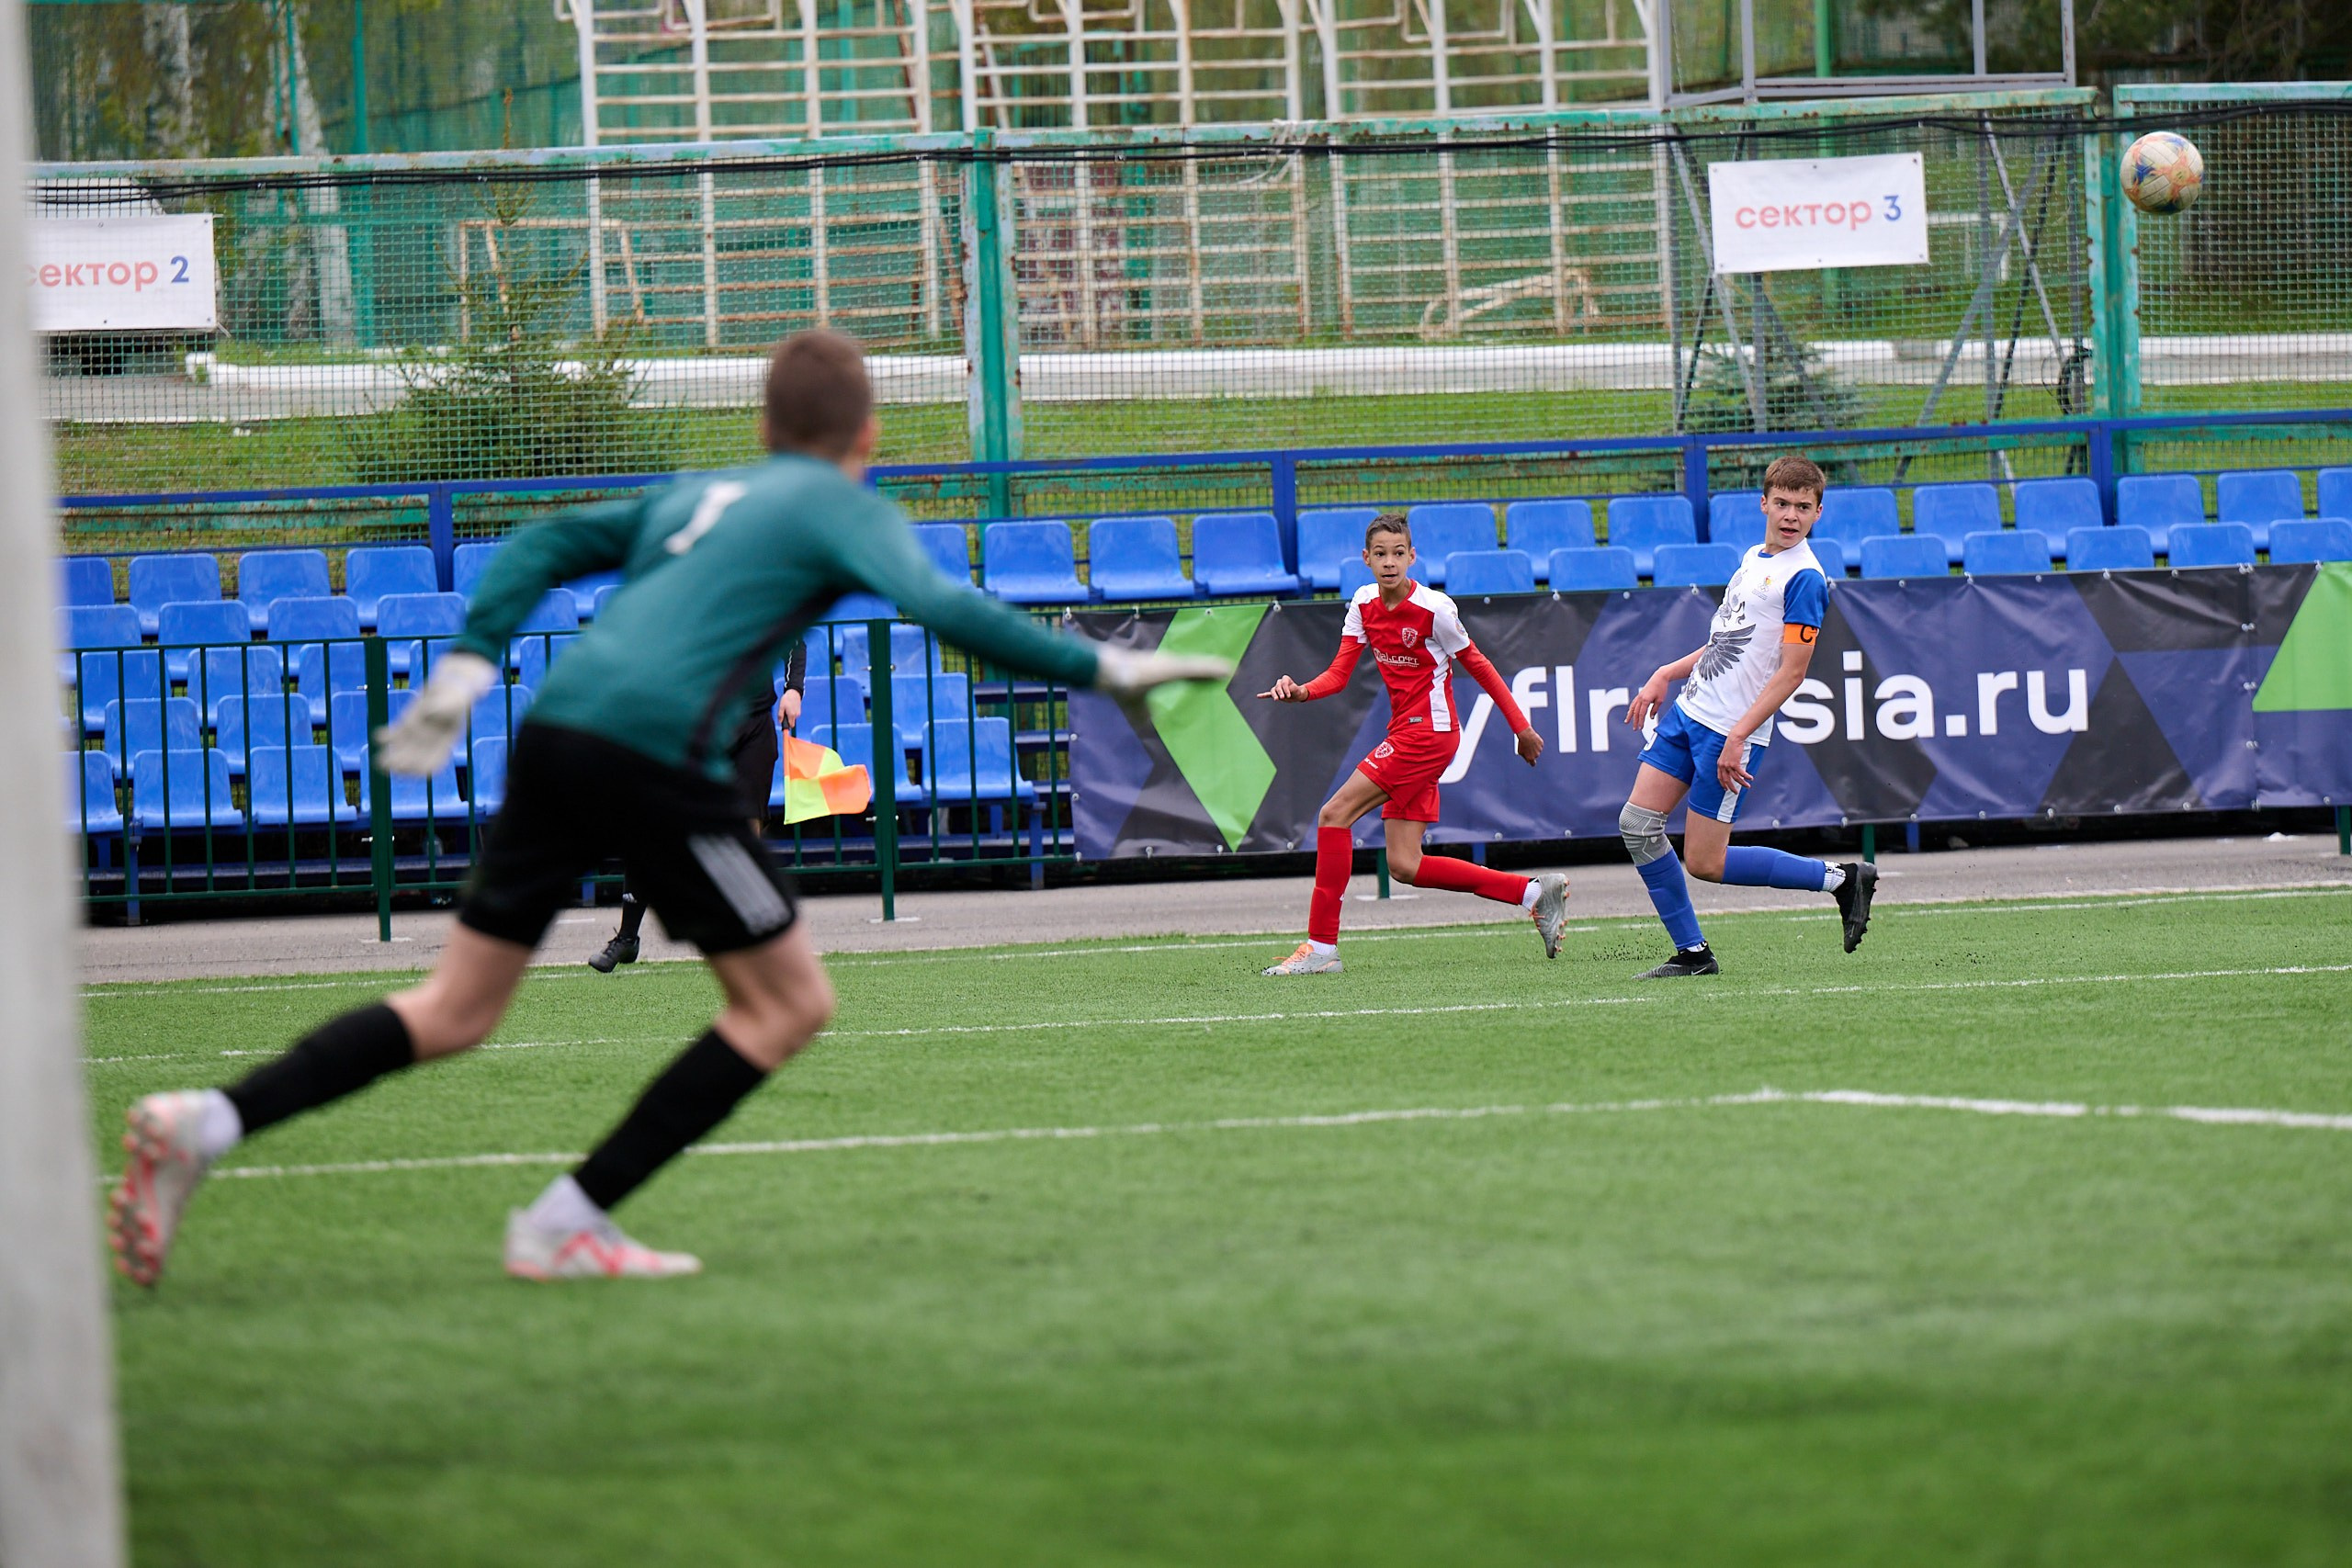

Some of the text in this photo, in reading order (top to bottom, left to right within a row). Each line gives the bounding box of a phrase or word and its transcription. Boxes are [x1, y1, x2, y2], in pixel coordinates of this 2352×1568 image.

[1735, 195, 1902, 231] сектор 3
[169, 255, 190, 284] 2
[1800, 625, 1815, 643] C
[1437, 650, 2089, 784] yflrsia.ru
